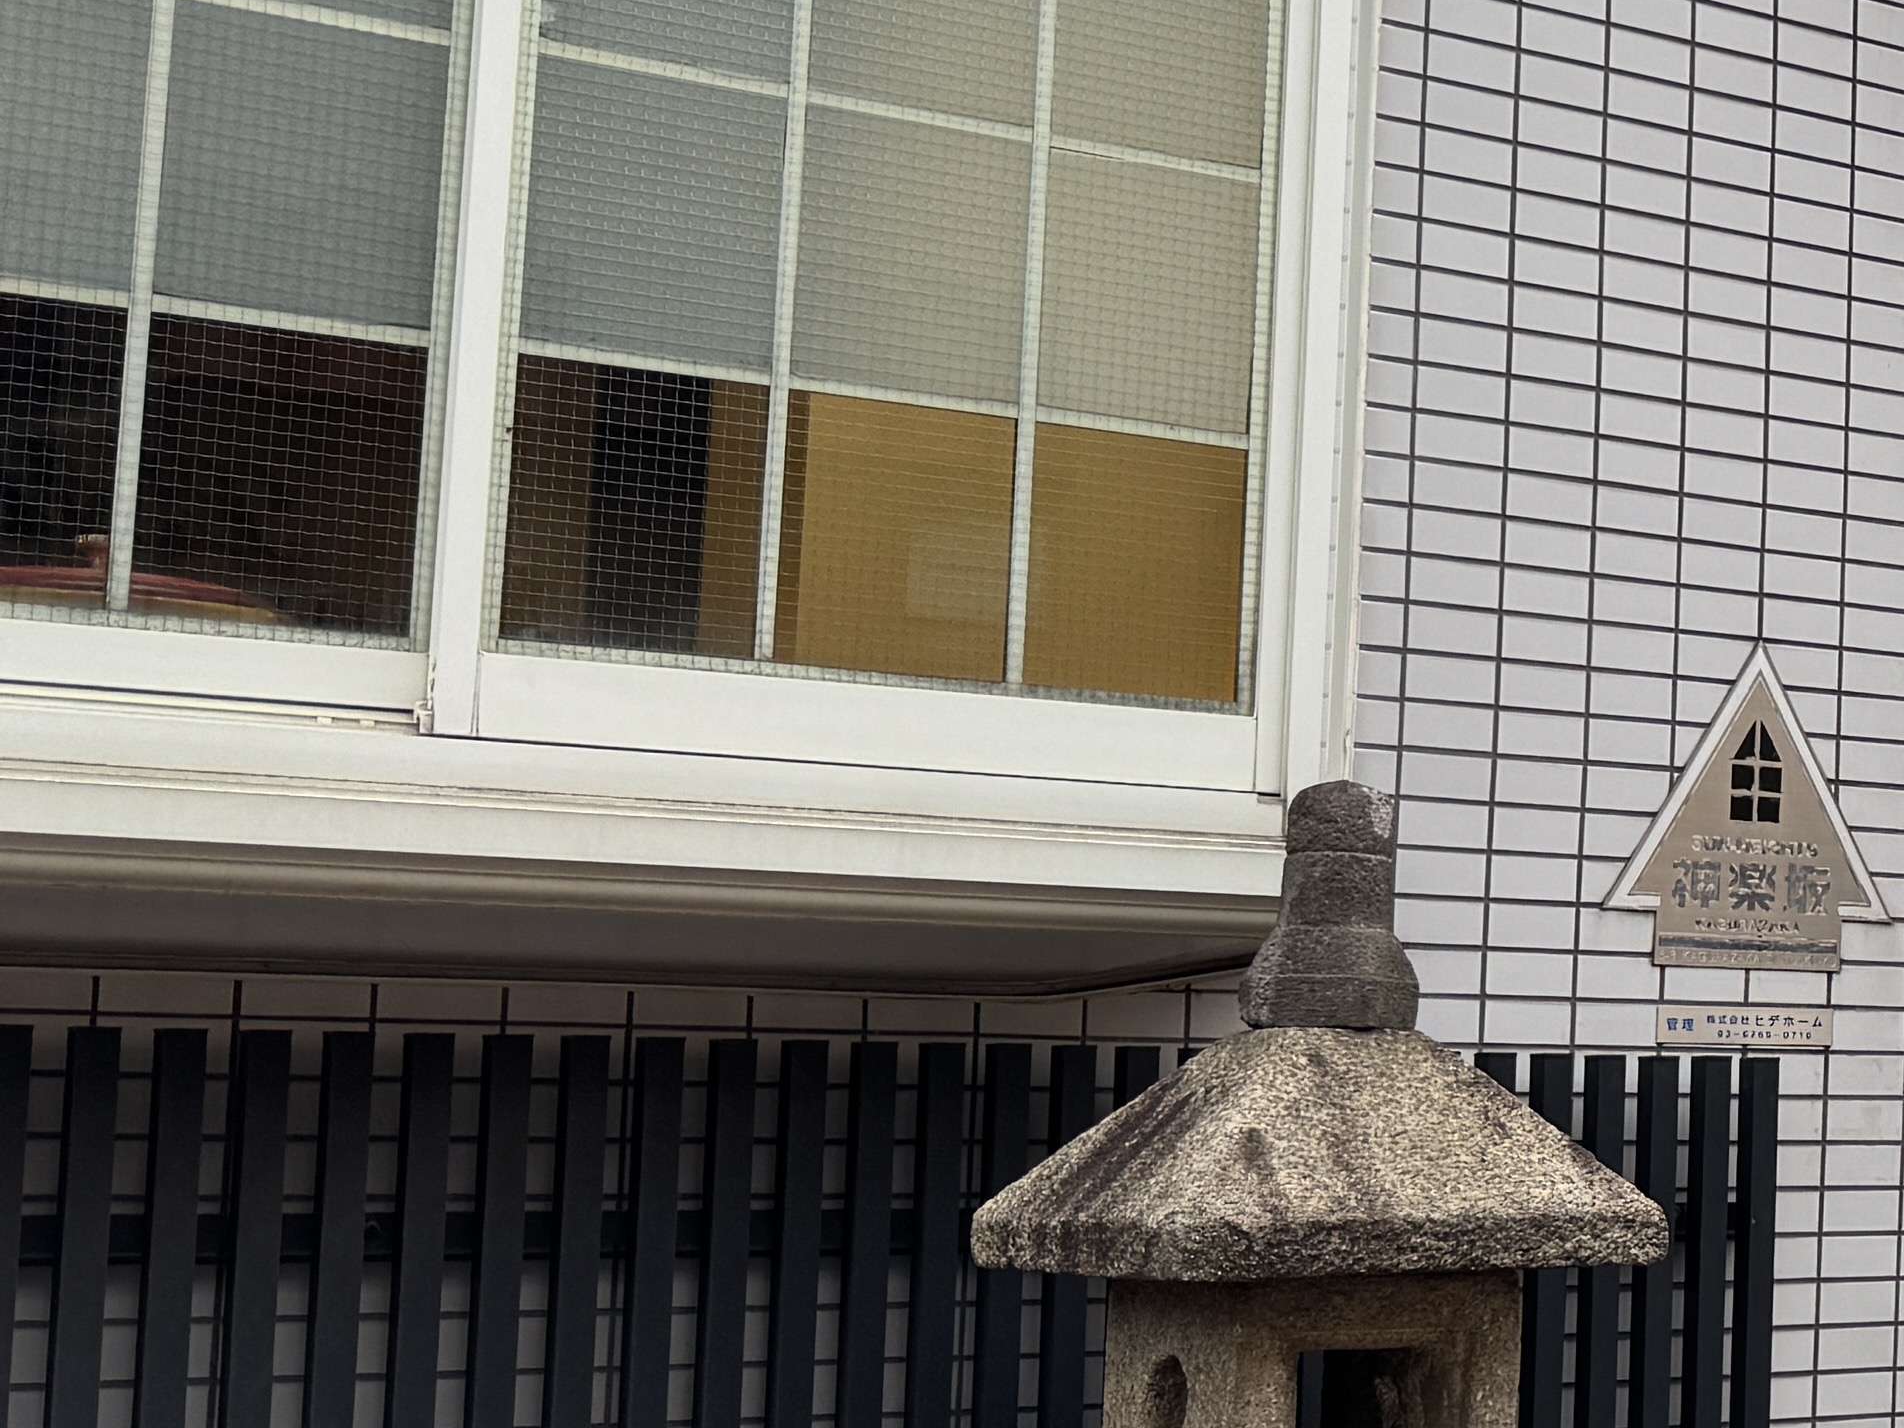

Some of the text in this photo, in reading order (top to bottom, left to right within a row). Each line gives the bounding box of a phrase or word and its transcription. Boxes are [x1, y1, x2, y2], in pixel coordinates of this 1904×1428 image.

[1671, 857, 1832, 916] 神楽坂
[1666, 1017, 1695, 1032] 管理
